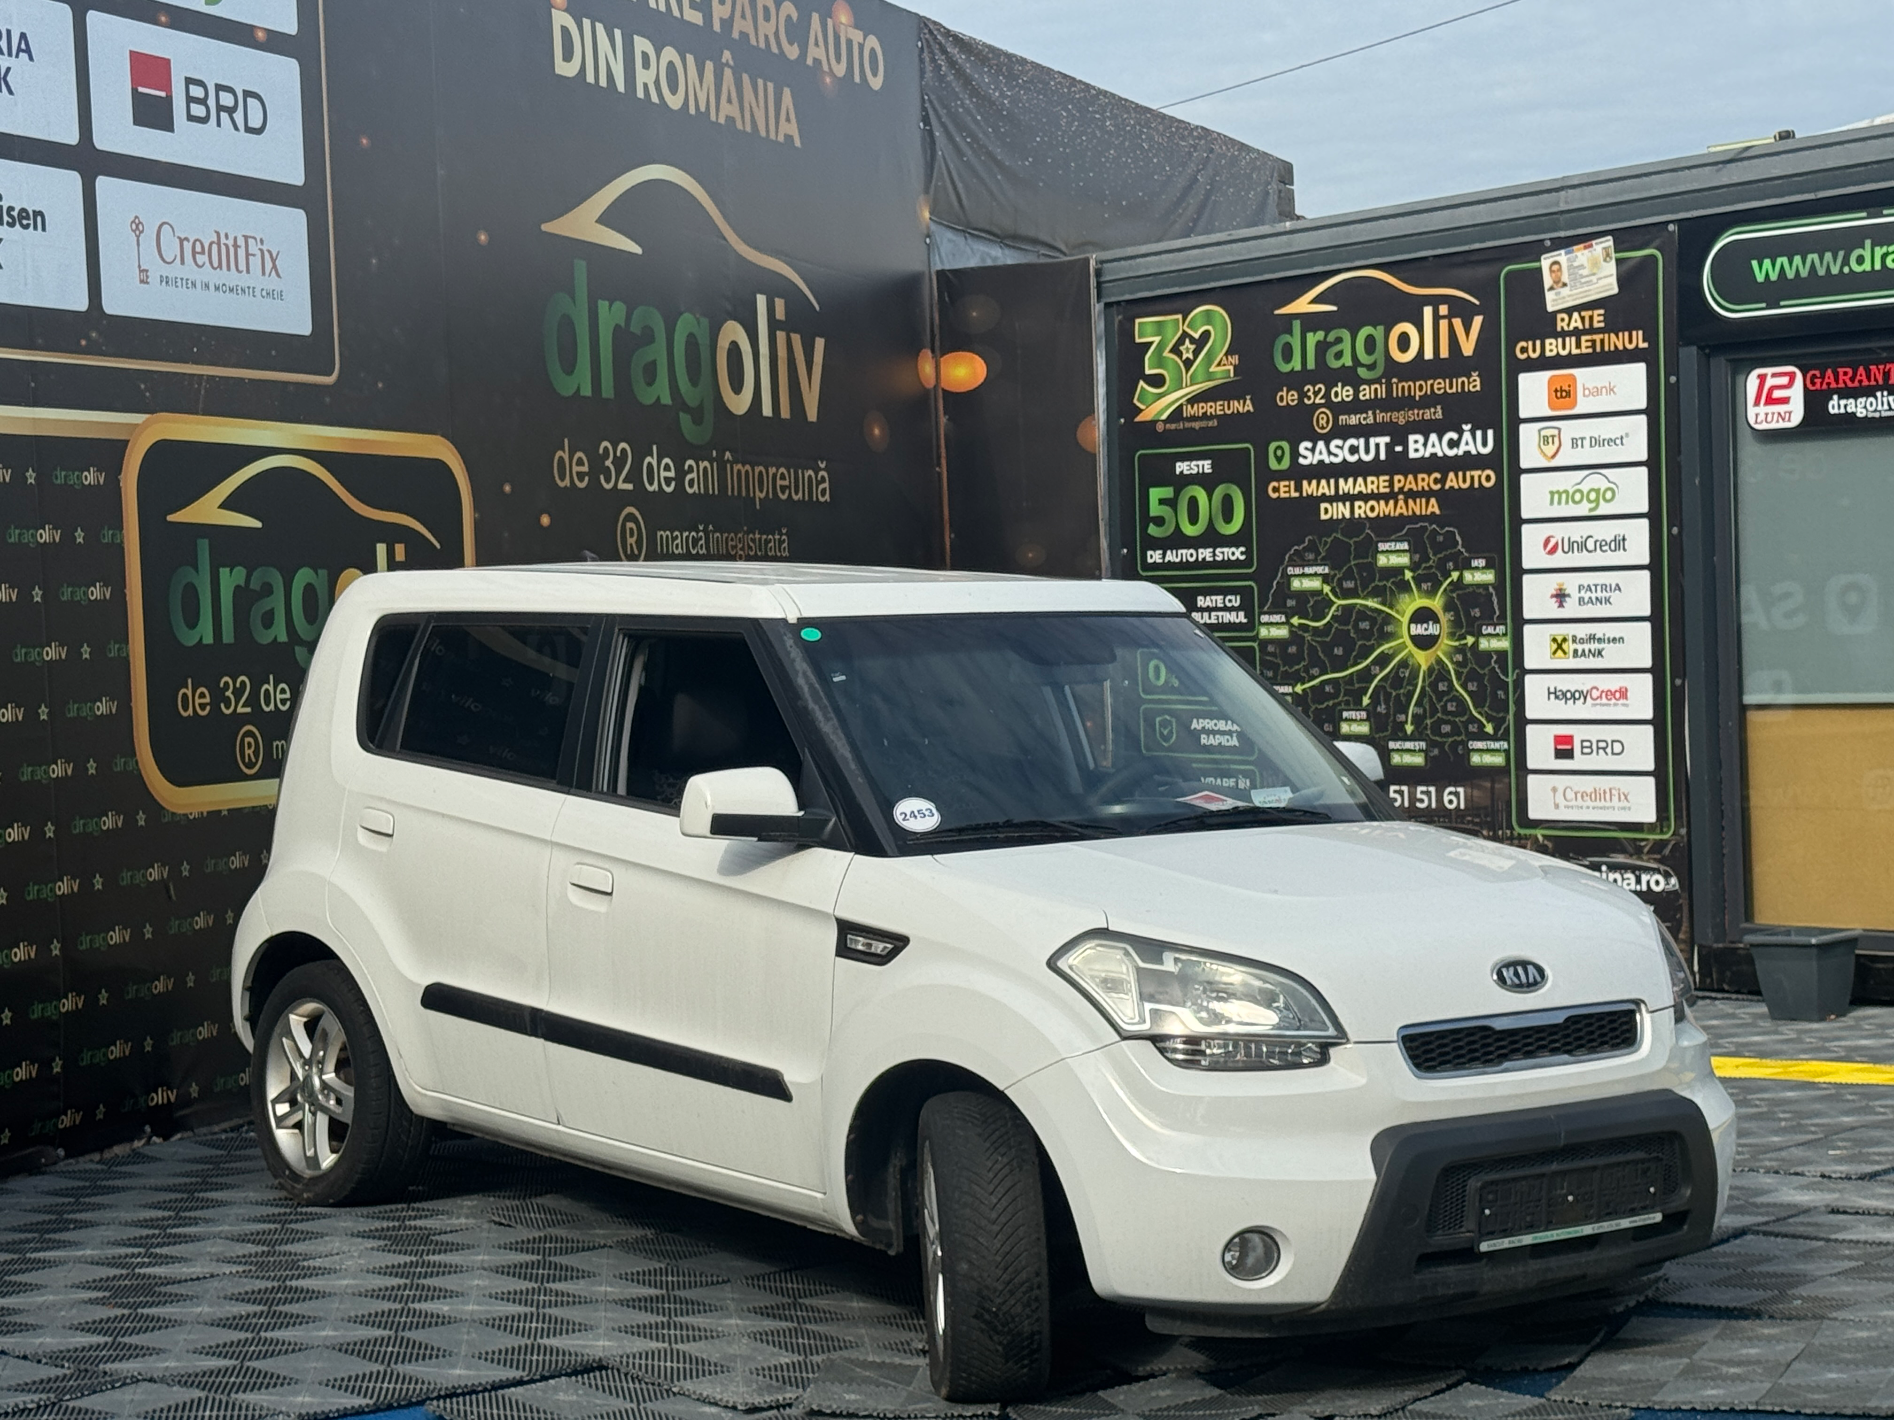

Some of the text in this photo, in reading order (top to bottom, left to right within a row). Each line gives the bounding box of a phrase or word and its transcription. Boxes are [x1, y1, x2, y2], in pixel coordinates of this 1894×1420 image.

[806, 12, 884, 91] AUTO
[551, 8, 801, 148] DIN ROMÂNIA
[184, 76, 268, 136] BRD
[156, 221, 282, 279] CreditFix
[160, 274, 285, 301] PRIETEN IN MOMENTE CHEIE
[1556, 309, 1605, 332] RATE
[543, 258, 825, 445] dragoliv
[1273, 304, 1484, 380] dragoliv
[1516, 330, 1649, 359] CU BULETINUL
[1133, 304, 1231, 410] 32
[1276, 371, 1481, 406] de 32 de ani împreună
[1553, 382, 1616, 399] tbi bank
[1753, 371, 1797, 407] 12
[1182, 395, 1254, 418] ÎMPREUNĂ
[1339, 409, 1374, 427] marcă
[1375, 405, 1443, 427] înregistrată
[1753, 411, 1793, 425] LUNI
[1298, 436, 1390, 465] SASCUT
[1408, 424, 1494, 460] BACĂU
[1542, 434, 1556, 447] BT
[1571, 437, 1586, 449] BT
[53, 466, 105, 489] dragoliv
[553, 437, 830, 510] de 32 de ani împreună
[1175, 460, 1213, 475] PESTE
[1268, 469, 1495, 498] CEL MAI MARE PARC AUTO
[1147, 483, 1245, 538] 500
[1320, 496, 1440, 520] DIN ROMÂNIA
[1549, 485, 1616, 513] mogo
[6, 524, 61, 547] dragoliv
[657, 524, 705, 555] marcă
[709, 524, 789, 561] înregistrată
[1377, 541, 1409, 551] SUCEAVA
[1562, 535, 1627, 554] UniCredit
[1147, 547, 1246, 563] DE AUTO PE STOC
[59, 582, 111, 605] dragoliv
[1578, 584, 1622, 594] PATRIA
[1578, 596, 1613, 606] BANK
[1197, 595, 1241, 608] RATE CU
[1409, 621, 1440, 635] BACĂU
[1572, 634, 1624, 646] Raiffeisen
[12, 641, 67, 666] dragoliv
[1572, 648, 1605, 659] BANK
[177, 674, 291, 717] de 32 de
[65, 697, 117, 720] dragoliv
[1200, 733, 1239, 747] RAPIDĂ
[1580, 739, 1625, 756] BRD
[18, 759, 73, 784] dragoliv
[1415, 785, 1436, 809] 51
[1443, 786, 1465, 810] 61
[1563, 786, 1630, 804] CreditFix
[71, 811, 124, 836] dragoliv
[900, 808, 935, 822] 2453
[24, 851, 249, 901] dragoliv dragoliv dragoliv
[78, 925, 131, 952] dragoliv
[167, 911, 214, 935] dragoliv
[1500, 964, 1541, 987] KIA
[29, 974, 174, 1020] dragoliv dragoliv
[78, 1040, 132, 1067] dragoliv
[168, 1021, 219, 1047] dragoliv
